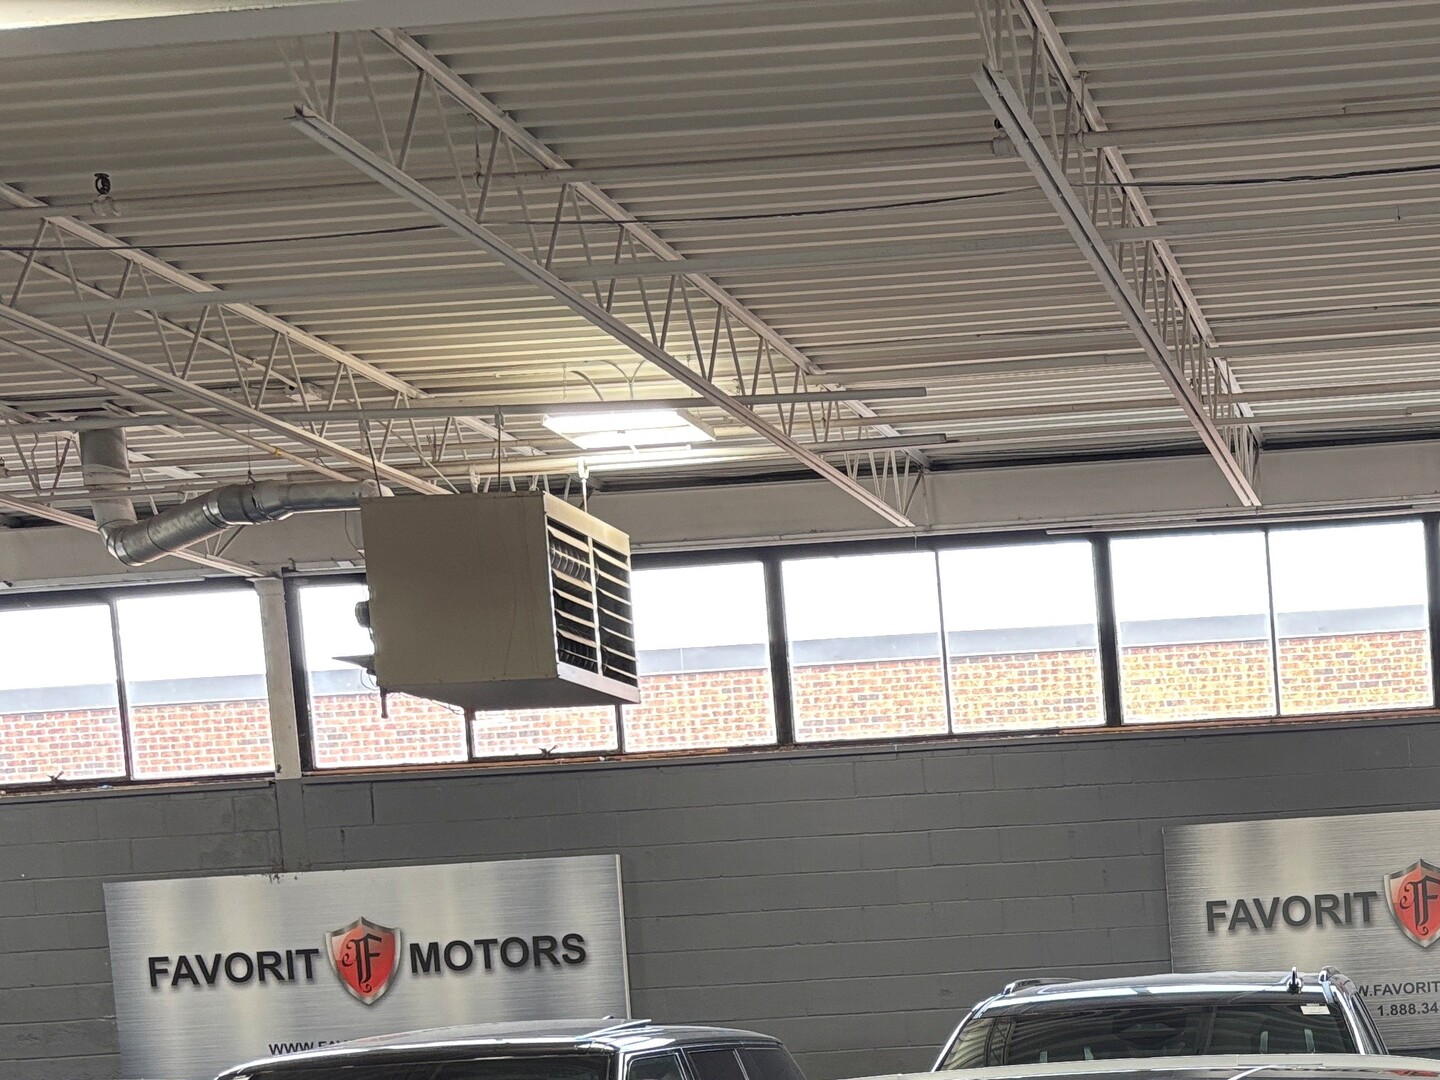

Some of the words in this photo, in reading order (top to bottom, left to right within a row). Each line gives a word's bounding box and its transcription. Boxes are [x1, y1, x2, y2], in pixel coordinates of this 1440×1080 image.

[1206, 891, 1377, 932] FAVORIT
[148, 948, 320, 987] FAVORIT
[410, 933, 587, 974] MOTORS
